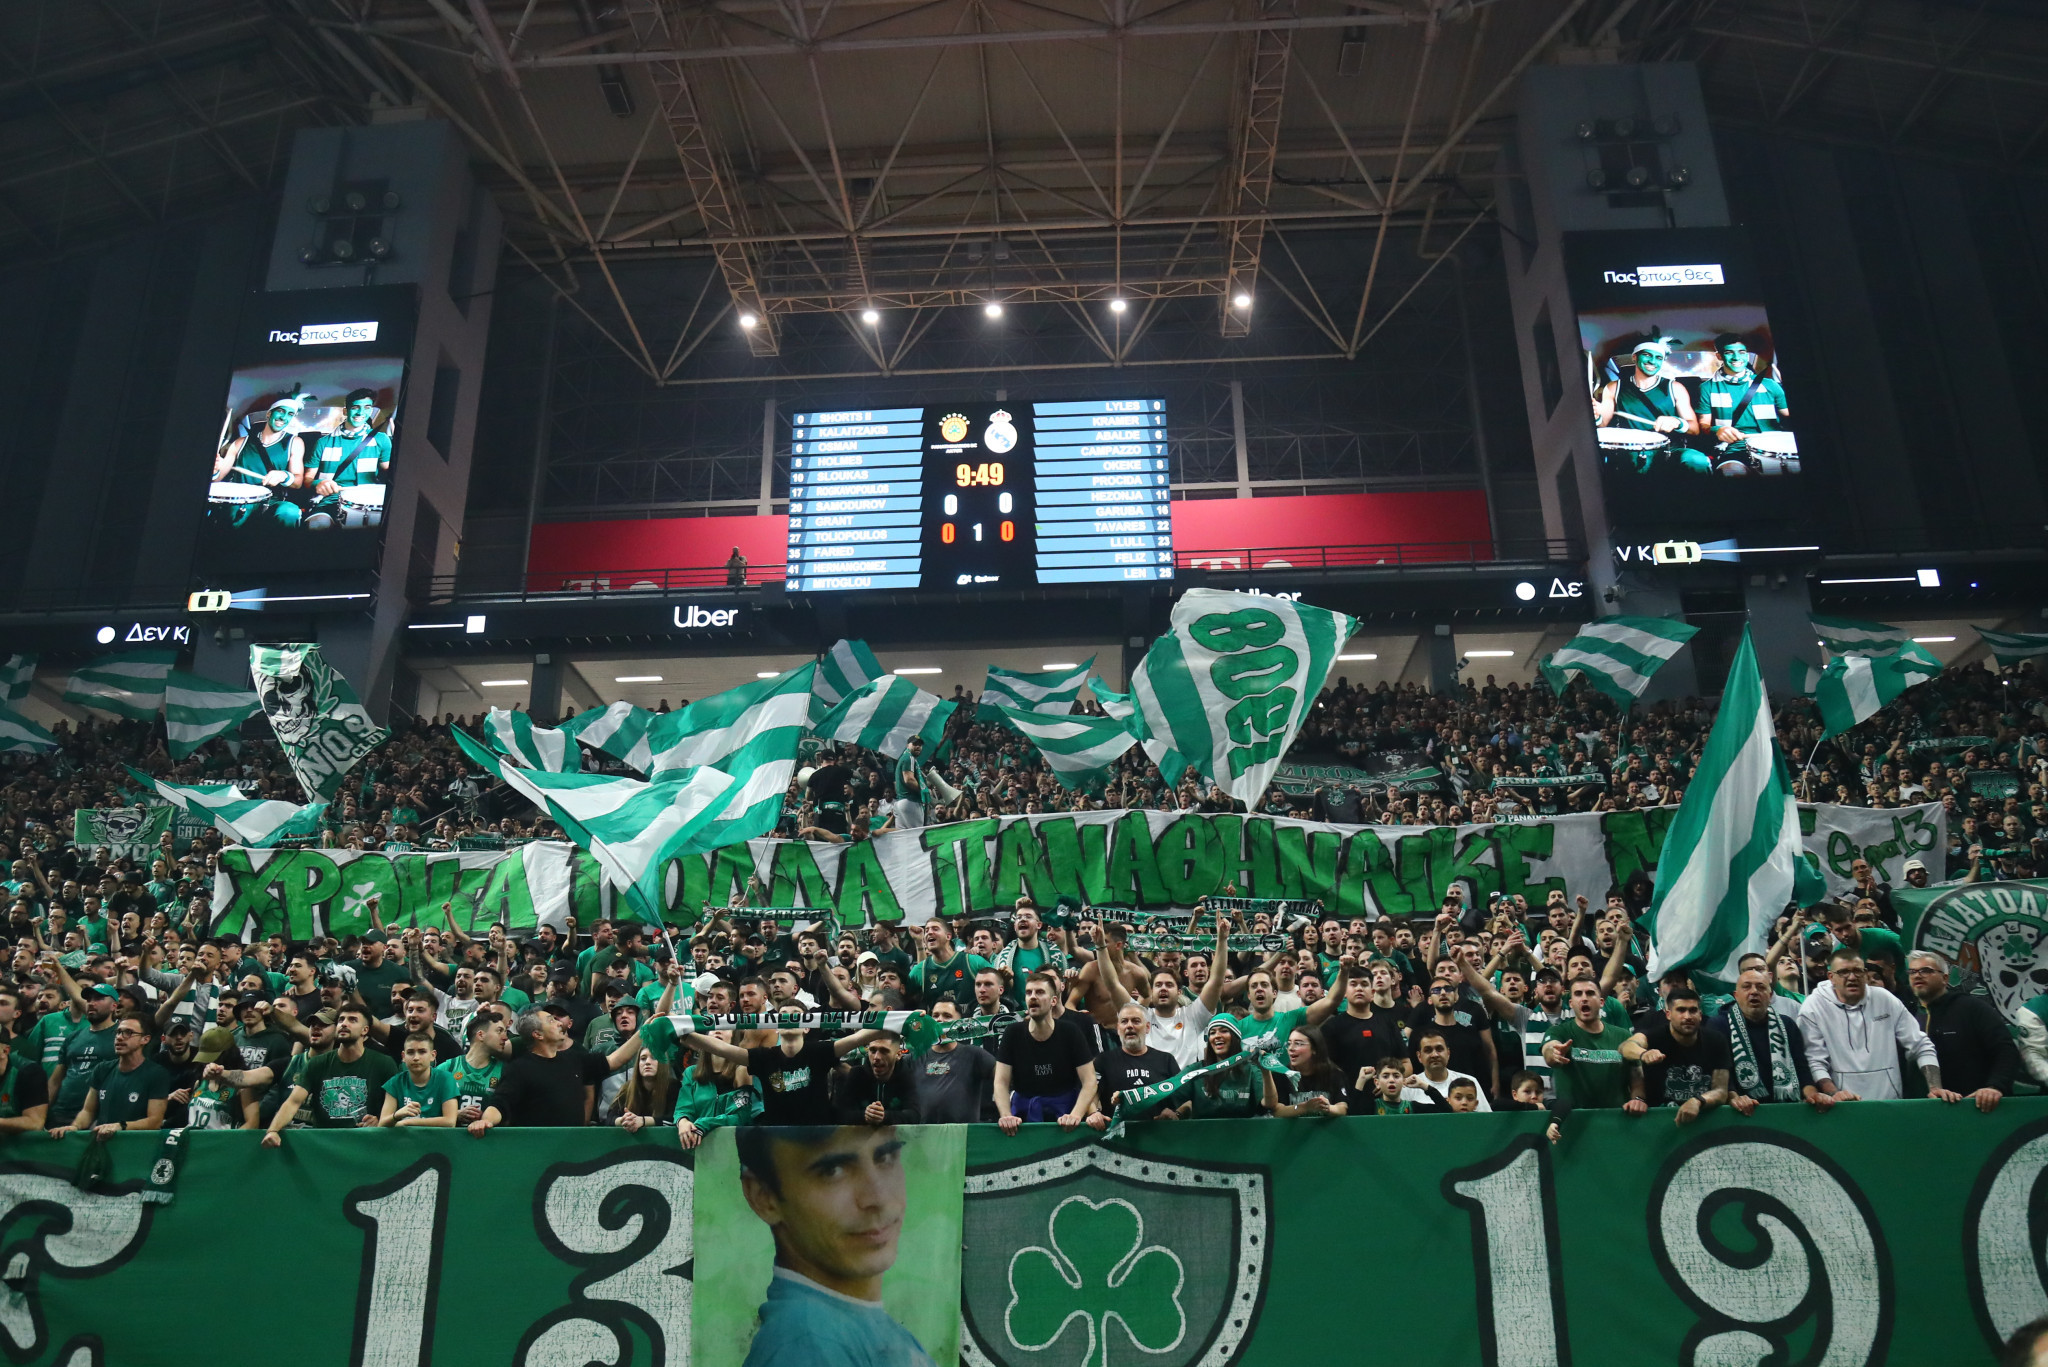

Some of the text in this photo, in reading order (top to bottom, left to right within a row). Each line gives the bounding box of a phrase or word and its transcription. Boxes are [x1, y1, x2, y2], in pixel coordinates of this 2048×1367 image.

[1604, 271, 1637, 285] Πας
[1684, 269, 1713, 282] θες
[269, 330, 299, 343] Πας
[342, 327, 368, 338] θες
[1106, 401, 1160, 411] LYLES 0
[797, 415, 804, 424] 0
[820, 413, 863, 423] SHORTS
[1093, 416, 1160, 426] KRAMER 1
[797, 426, 888, 438] 5 KALAITZAKIS
[1096, 430, 1162, 441] ABALDE 6
[796, 441, 858, 453] 6 OSMAN
[1081, 445, 1162, 456] CAMPAZZO 7
[795, 456, 862, 468] 8 HOLMES
[1103, 460, 1164, 470] OKEKE 8
[792, 470, 868, 482] 10 SLOUKAS
[956, 462, 1004, 487] 9:49
[1092, 475, 1164, 486] PROCIDA 9
[792, 488, 803, 497] 17
[1091, 490, 1167, 501] HEZONJA 11
[791, 500, 886, 513] 20 SAMODUROV
[944, 492, 1012, 516] 0 0
[1096, 506, 1168, 516] GARUBA 16
[790, 516, 854, 528] 22 GRANT
[1094, 521, 1169, 532] TAVARES 22
[789, 530, 887, 543] 27 TOLIOPOULOS
[942, 521, 1014, 544] 0 1 0
[1110, 536, 1170, 547] LLULL 23
[789, 547, 854, 558] 35 FARIED
[1115, 552, 1171, 563] FELIZ 24
[788, 561, 886, 574] 41 HERNANGOMEZ
[1124, 568, 1172, 578] LEN 25
[787, 578, 871, 589] 44 MITOGLOU
[674, 606, 738, 628] Uber
[125, 622, 170, 641] Δεν
[1126, 1069, 1139, 1078] PAO
